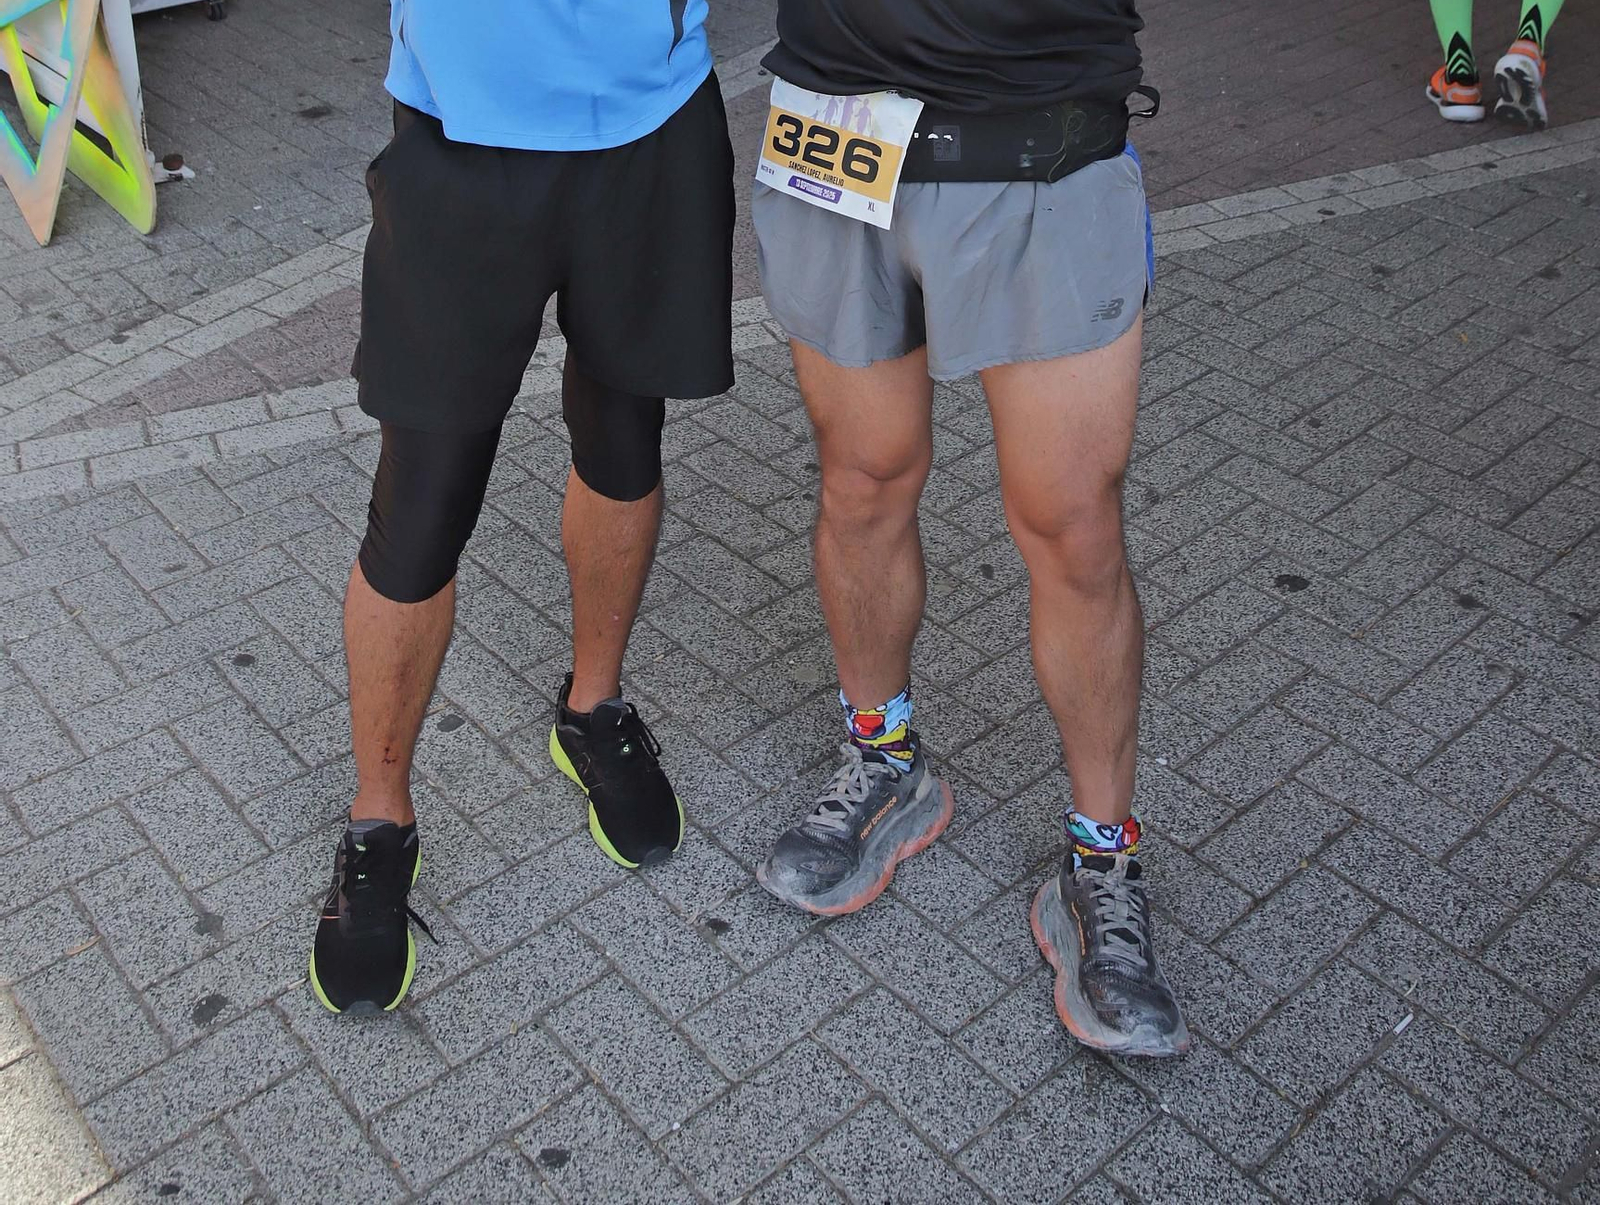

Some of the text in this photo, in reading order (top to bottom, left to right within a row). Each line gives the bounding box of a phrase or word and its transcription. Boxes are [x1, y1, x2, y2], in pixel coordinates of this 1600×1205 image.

[773, 114, 882, 183] 326
[867, 201, 875, 213] XL
[860, 795, 898, 841] new balance
